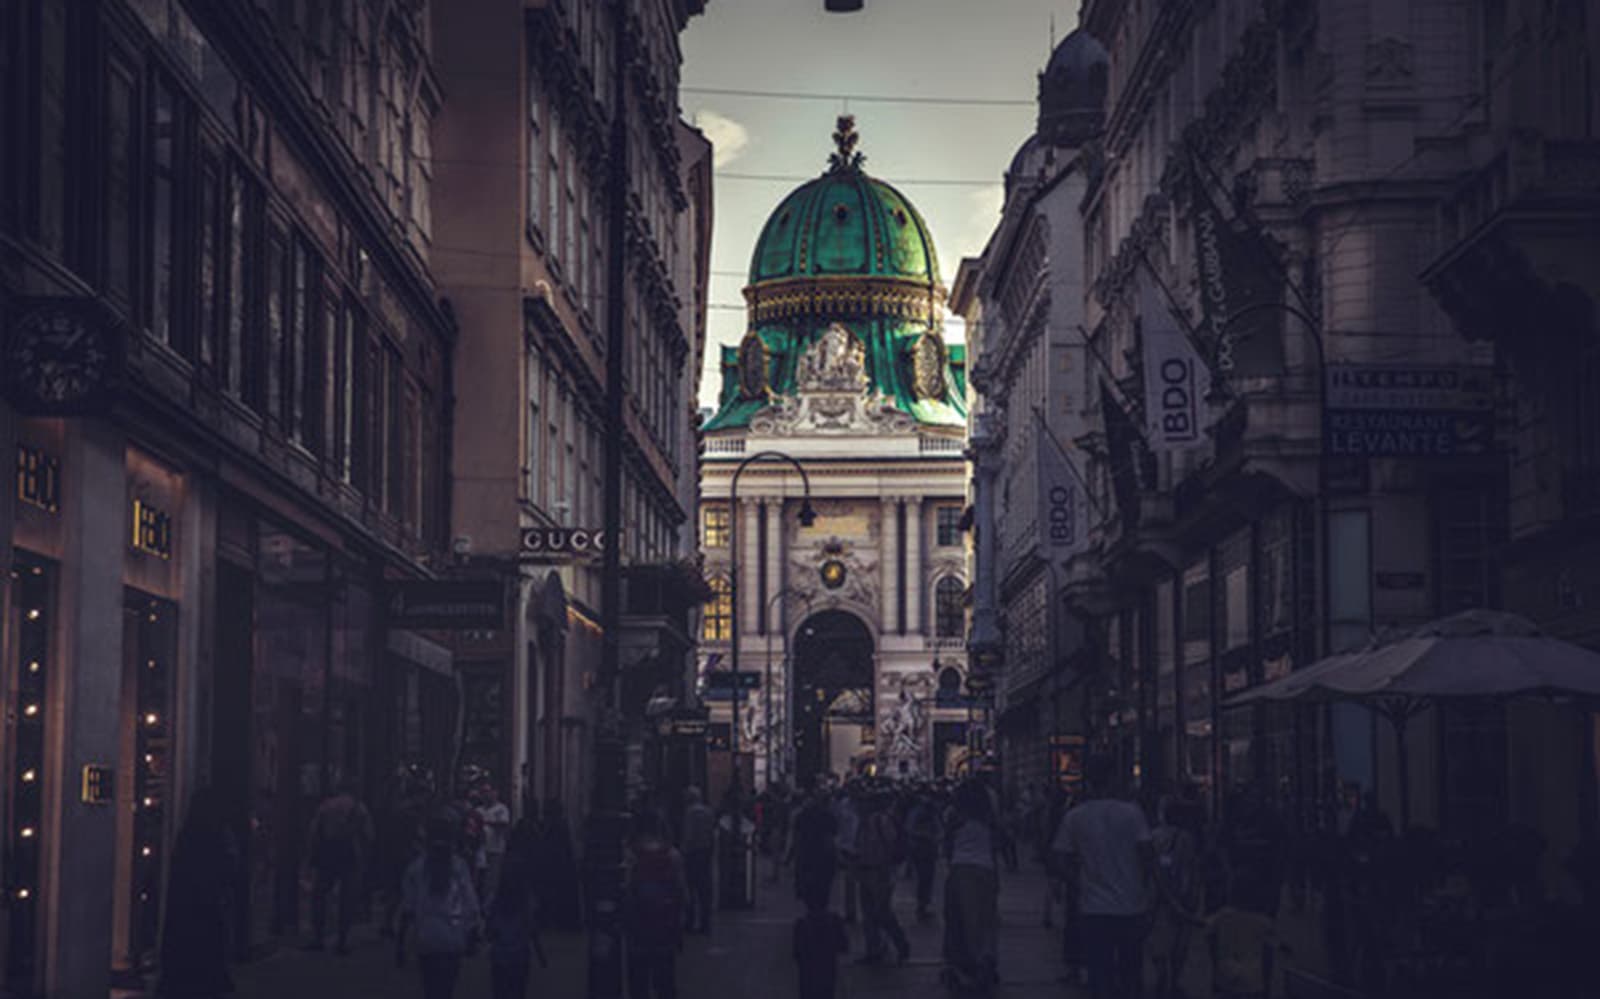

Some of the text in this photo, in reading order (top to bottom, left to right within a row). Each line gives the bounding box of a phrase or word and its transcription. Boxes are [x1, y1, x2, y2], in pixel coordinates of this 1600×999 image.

[1161, 357, 1190, 433] BDO
[1330, 430, 1451, 454] LEVANTE
[1049, 485, 1069, 539] BDO
